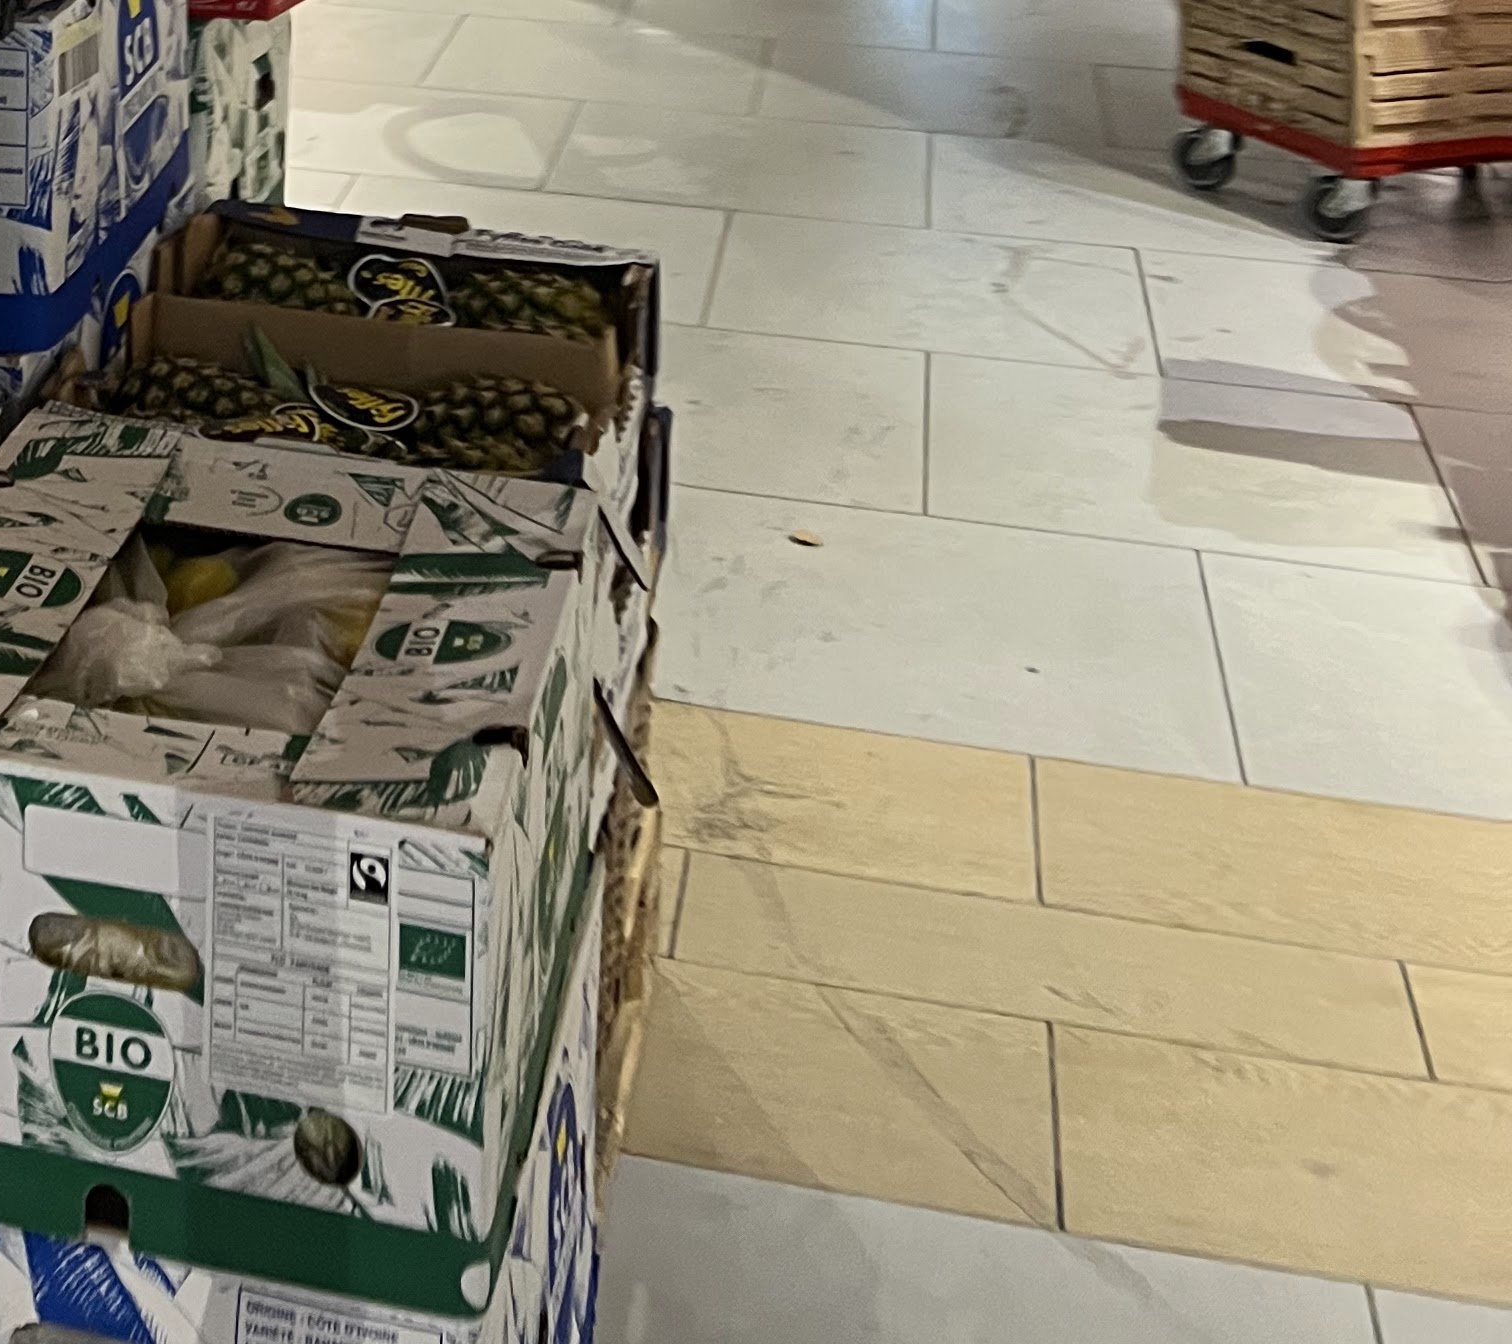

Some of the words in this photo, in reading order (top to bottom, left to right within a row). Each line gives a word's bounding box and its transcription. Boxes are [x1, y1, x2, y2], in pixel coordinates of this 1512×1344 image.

[15, 564, 57, 599] BIO
[404, 626, 440, 657] BIO
[76, 1026, 153, 1070] BIO
[92, 1096, 129, 1121] SCB
